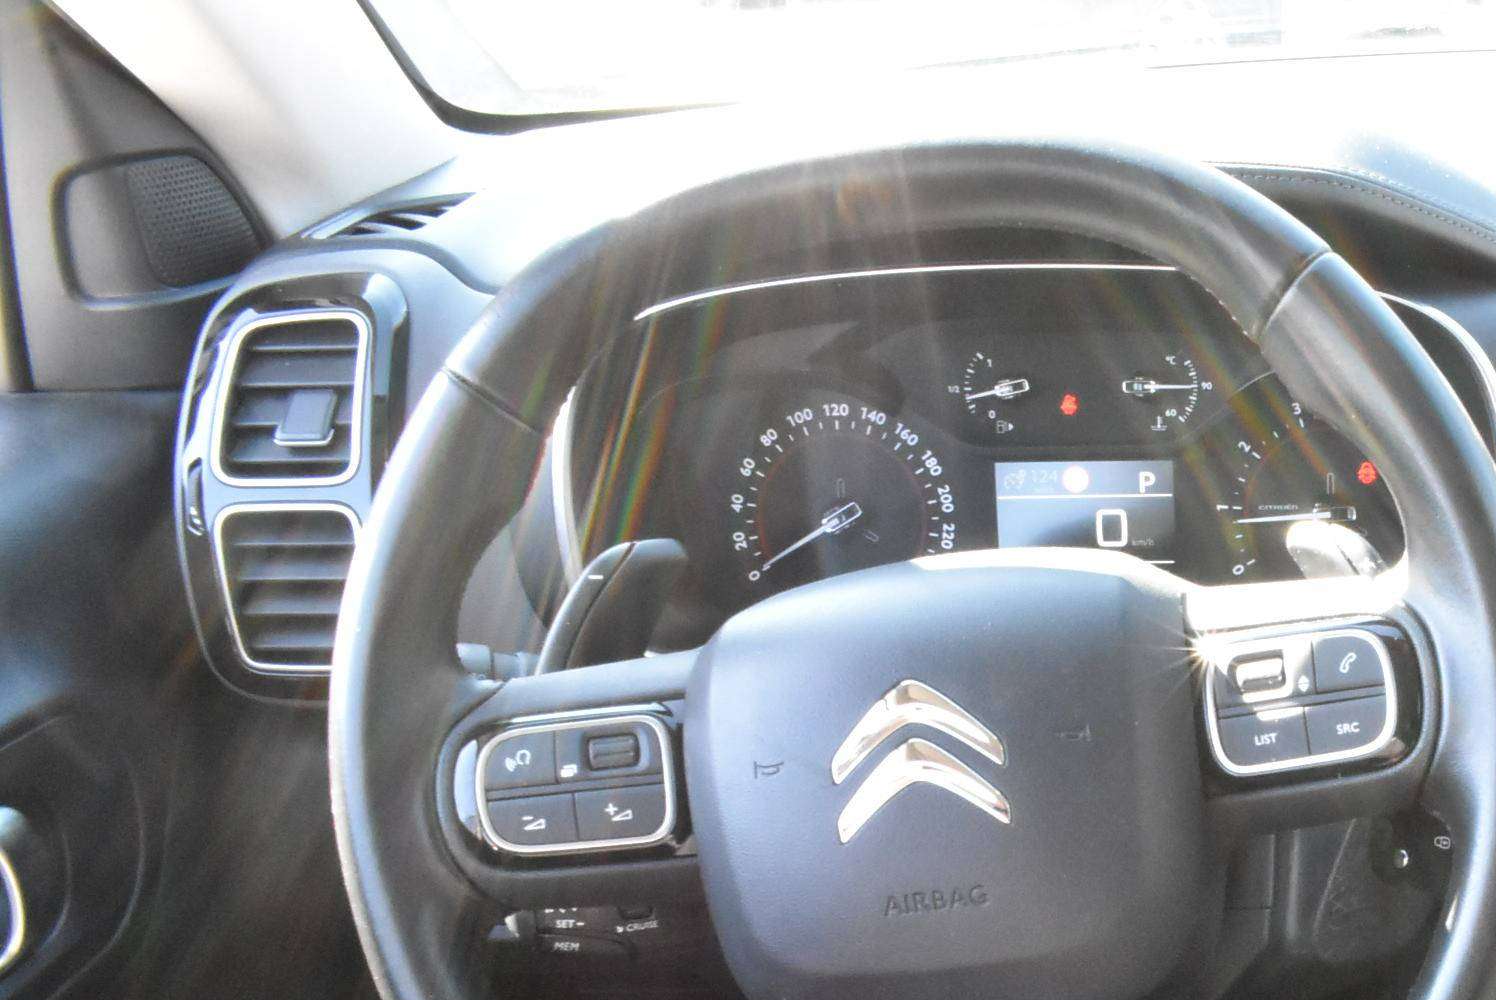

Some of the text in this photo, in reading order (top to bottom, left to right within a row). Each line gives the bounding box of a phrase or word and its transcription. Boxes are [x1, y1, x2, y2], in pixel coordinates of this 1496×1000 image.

[1201, 381, 1213, 391] 90
[786, 408, 814, 427] 100
[822, 403, 849, 417] 120
[860, 407, 887, 425] 140
[1165, 408, 1177, 417] 60
[1292, 402, 1302, 415] 3
[760, 428, 778, 447] 80
[895, 423, 919, 446] 160
[1238, 441, 1251, 453] 2
[740, 458, 756, 477] 60
[921, 450, 942, 477] 180
[1139, 471, 1156, 494] P
[731, 494, 744, 513] 40
[937, 485, 955, 513] 200
[941, 523, 955, 550] 220
[1096, 508, 1128, 547] 0
[732, 532, 748, 550] 20
[748, 570, 761, 582] 0
[1232, 564, 1245, 575] 0
[1336, 722, 1360, 735] SRC
[1254, 732, 1278, 746] LIST
[883, 884, 990, 917] AIRBAG
[554, 941, 580, 951] MEM
